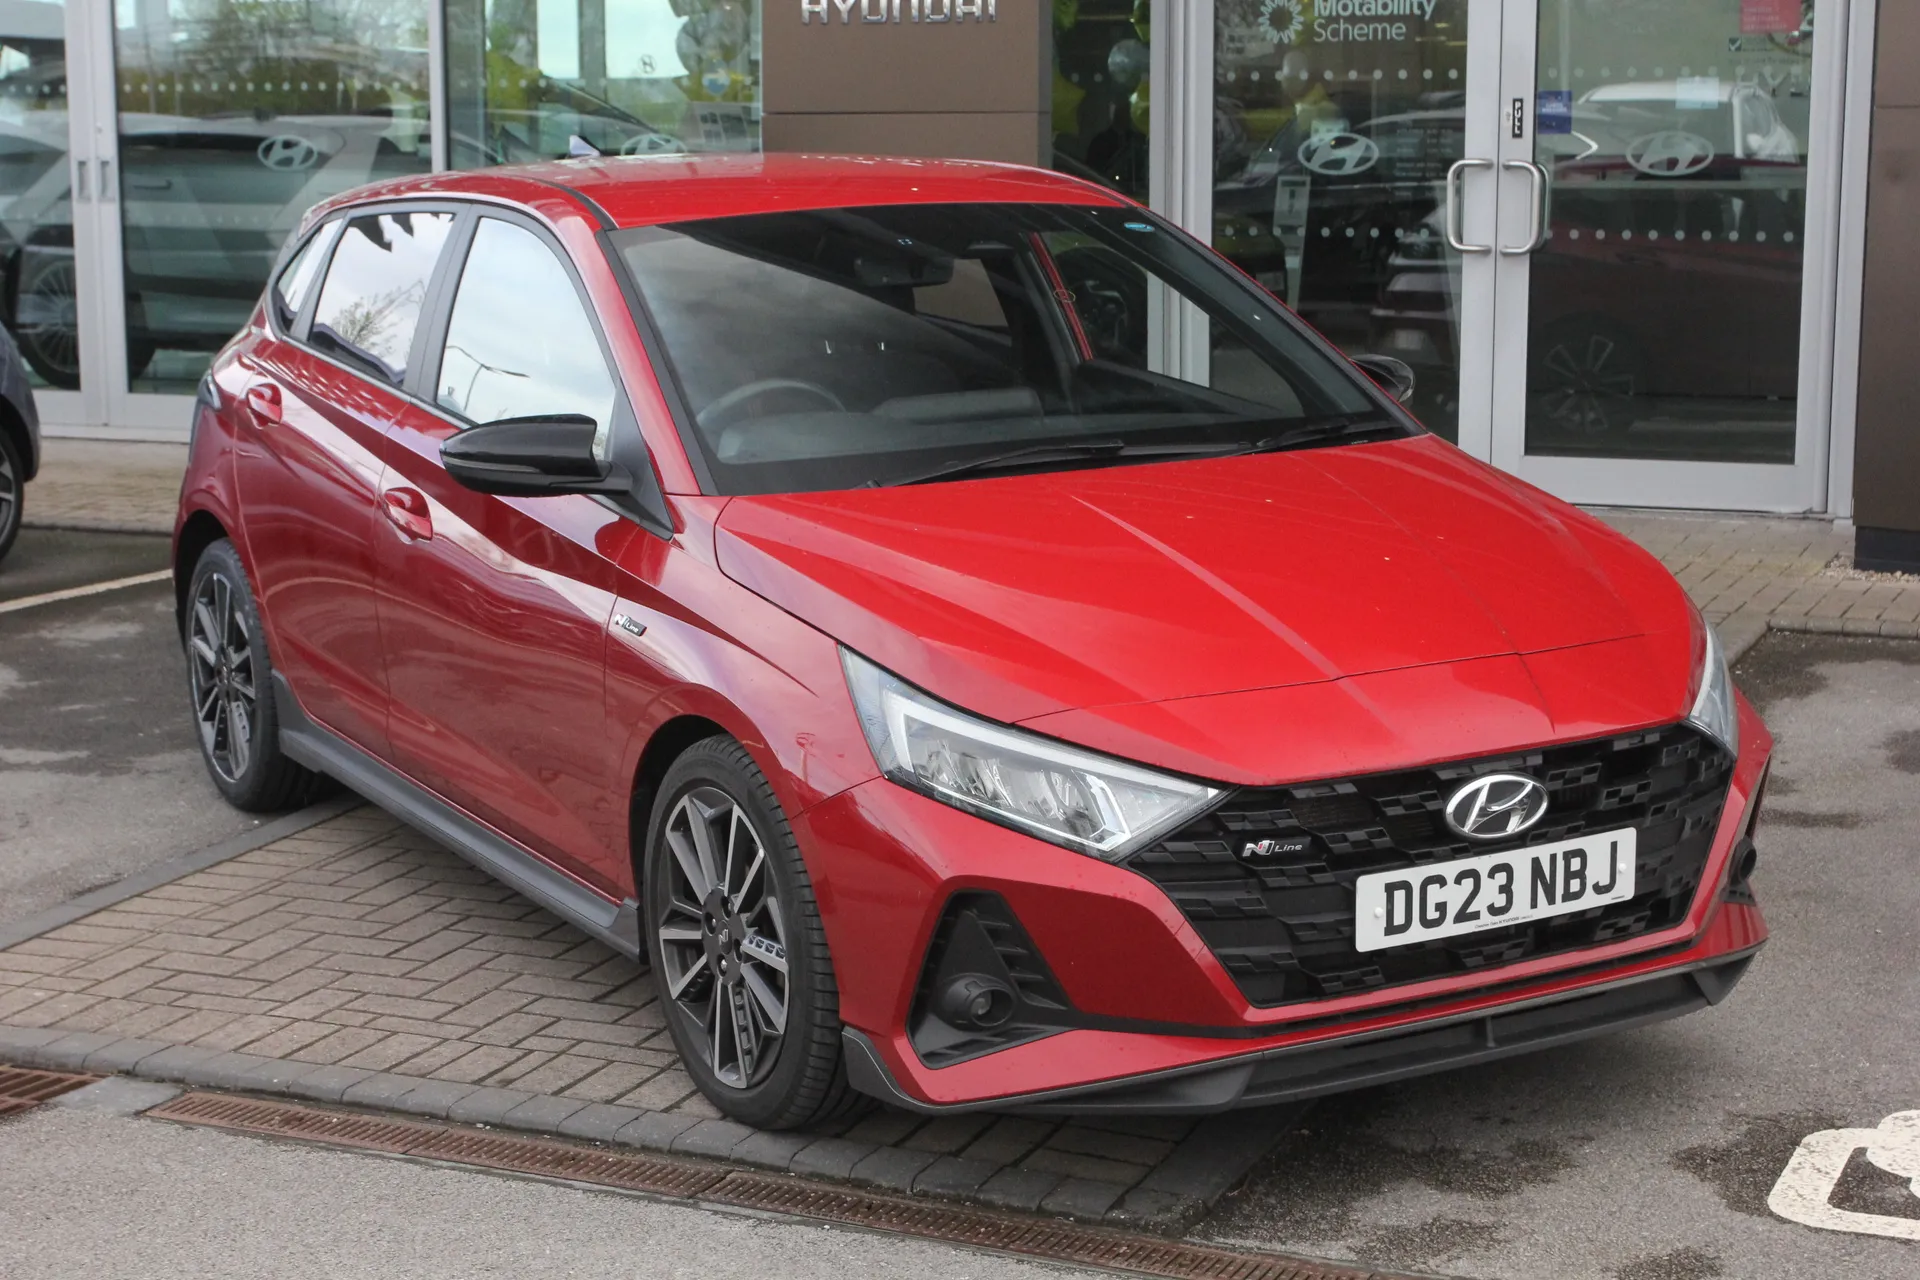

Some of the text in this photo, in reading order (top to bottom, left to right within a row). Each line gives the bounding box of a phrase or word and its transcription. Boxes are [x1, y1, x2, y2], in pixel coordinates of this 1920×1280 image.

[801, 0, 996, 25] HYUNDAI
[1313, 0, 1436, 20] Motability
[1313, 19, 1406, 42] Scheme
[1514, 100, 1522, 135] PULL
[1274, 844, 1303, 852] Line
[1384, 840, 1618, 937] DG23 NBJ
